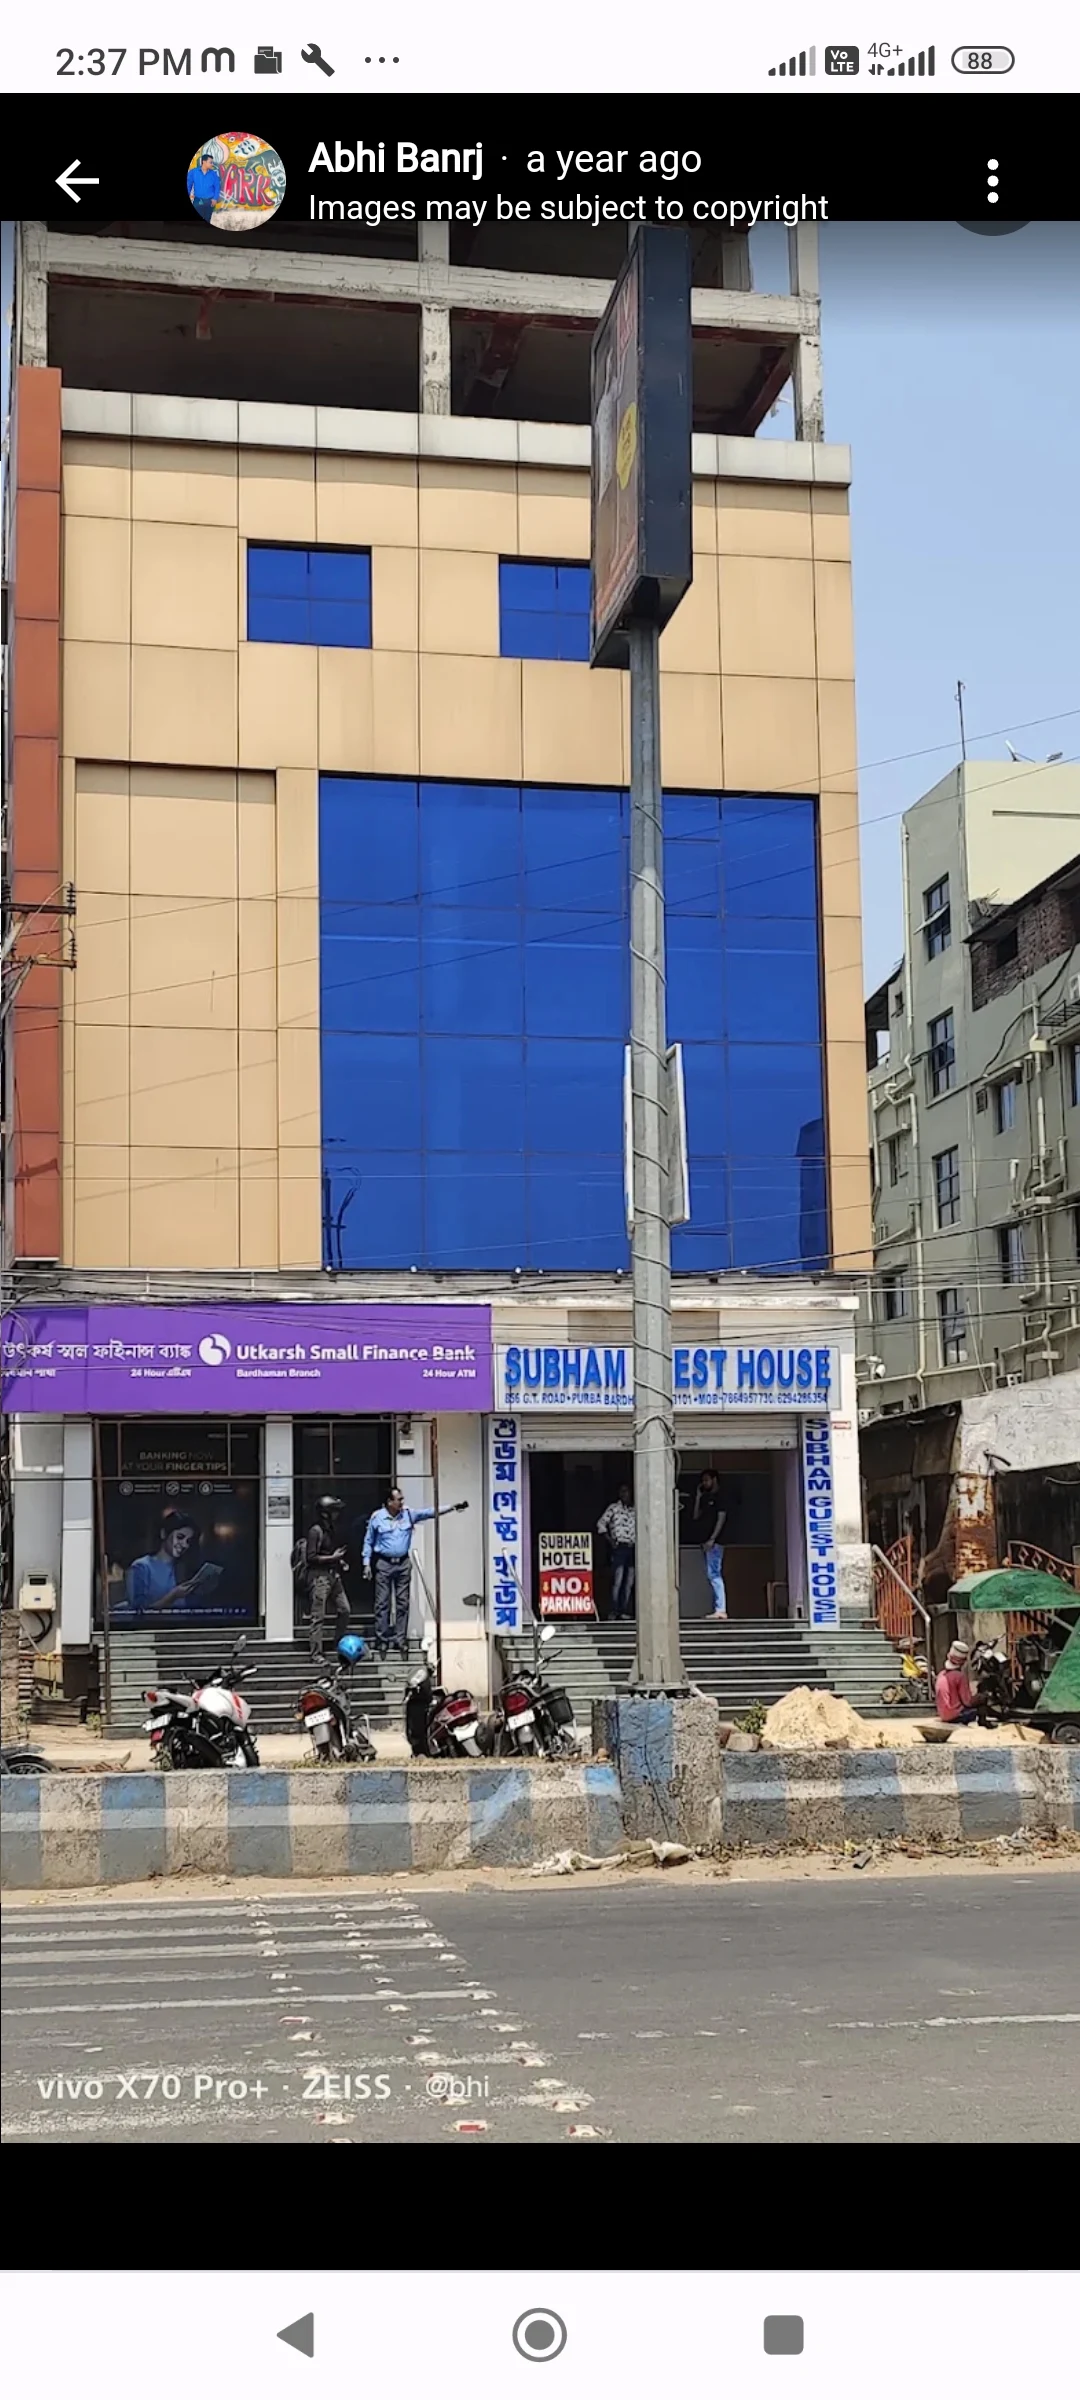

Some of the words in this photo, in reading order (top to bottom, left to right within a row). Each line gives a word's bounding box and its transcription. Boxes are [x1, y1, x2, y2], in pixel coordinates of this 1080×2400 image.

[236, 1344, 306, 1361] Utkarsh
[310, 1344, 359, 1361] Small
[363, 1345, 429, 1361] Finance
[432, 1346, 476, 1361] Bank
[143, 1368, 165, 1378] Hour
[236, 1368, 288, 1378] Bardhaman
[289, 1368, 321, 1378] Branch
[422, 1369, 434, 1378] 24
[434, 1369, 456, 1378] Hour
[457, 1369, 476, 1378] ATM
[504, 1347, 626, 1388] SUBHAM
[737, 1349, 833, 1388] HOUSE
[139, 1451, 187, 1461] BANKING
[805, 1418, 831, 1491] SUBHAM
[165, 1462, 204, 1471] FINGER
[206, 1462, 228, 1471] TIPS
[808, 1496, 834, 1557] GUEST
[541, 1534, 590, 1550] SUBHAM
[542, 1551, 590, 1566] HOTEL
[550, 1577, 582, 1595] NO
[812, 1562, 838, 1623] HOUSE
[541, 1596, 592, 1613] PARKING
